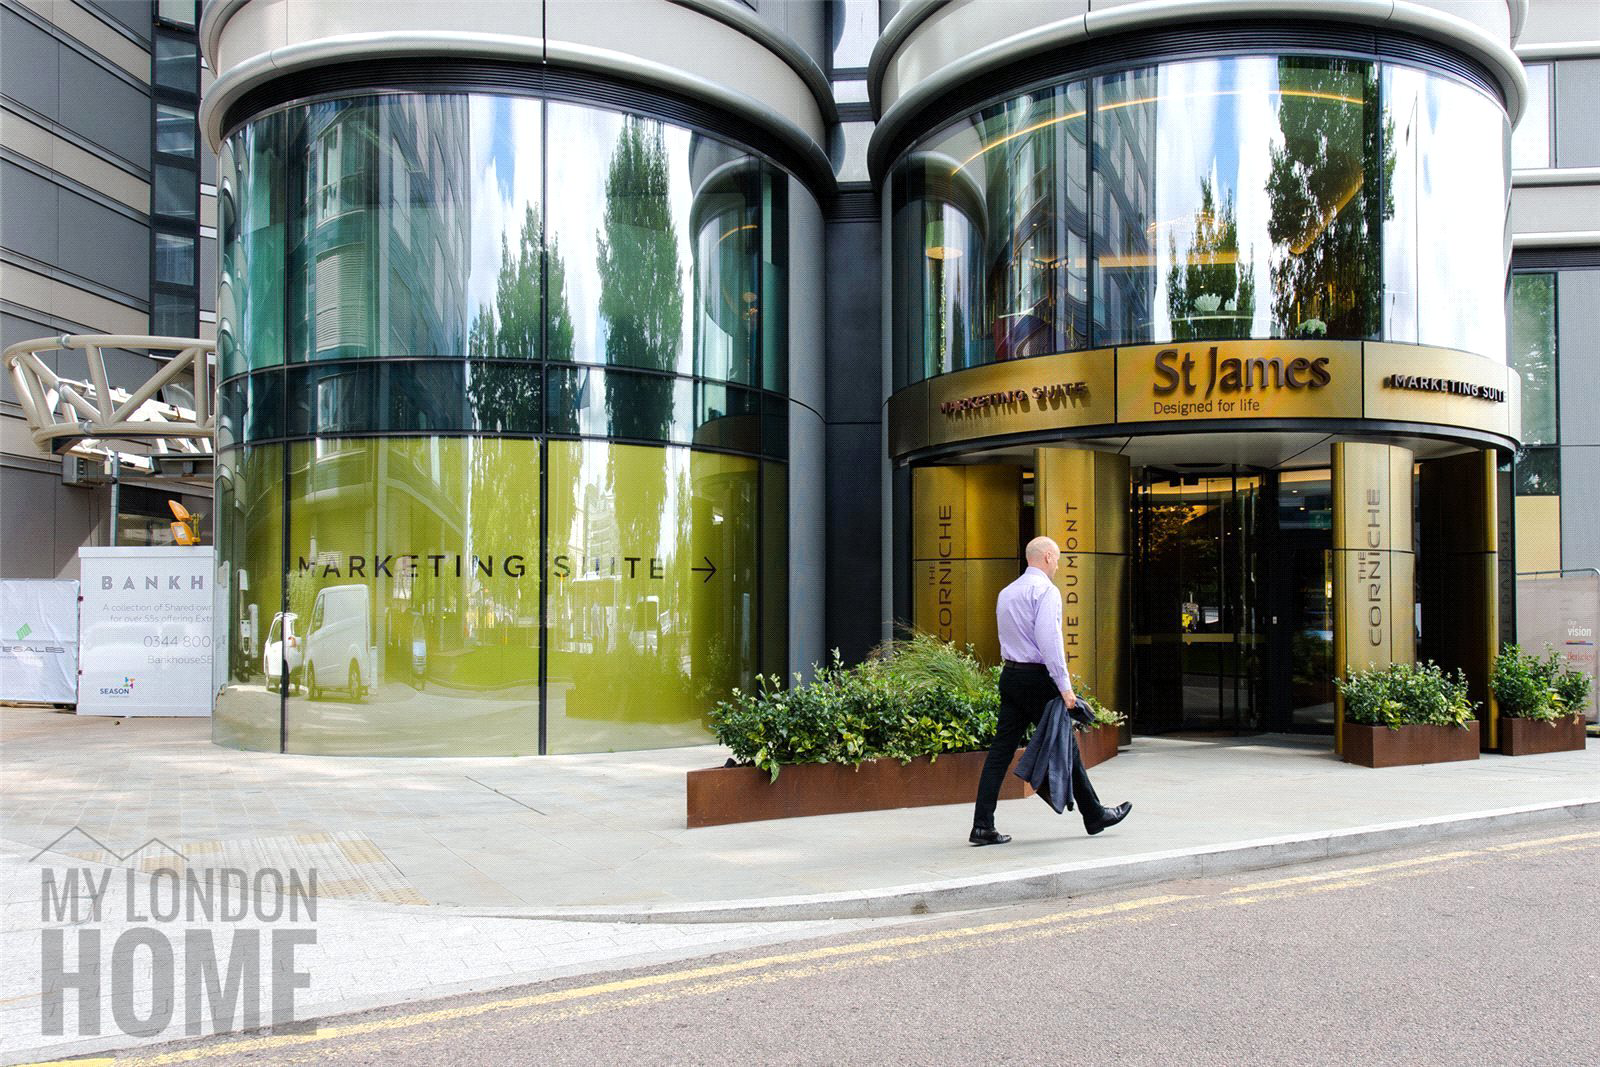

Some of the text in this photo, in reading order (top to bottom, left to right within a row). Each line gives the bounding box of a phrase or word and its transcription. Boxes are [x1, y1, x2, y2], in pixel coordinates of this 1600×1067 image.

[1153, 346, 1331, 400] St James
[940, 382, 1088, 414] MARKETING SUITE
[1391, 374, 1506, 402] MARKETING SUITE
[1154, 398, 1260, 417] Designed for life
[298, 555, 526, 578] MARKETING
[938, 505, 952, 643] CORNICHE
[1358, 552, 1367, 583] THE
[1367, 488, 1382, 647] CORNICHE
[101, 575, 204, 590] BANKH
[1066, 502, 1079, 663] THE DUMONT
[110, 615, 121, 623] for
[144, 615, 159, 623] 55s
[161, 615, 194, 625] offering
[111, 603, 152, 612] collection
[154, 603, 163, 612] of
[165, 603, 194, 612] Shared
[143, 635, 211, 647] 0344 800
[1567, 626, 1592, 637] vision
